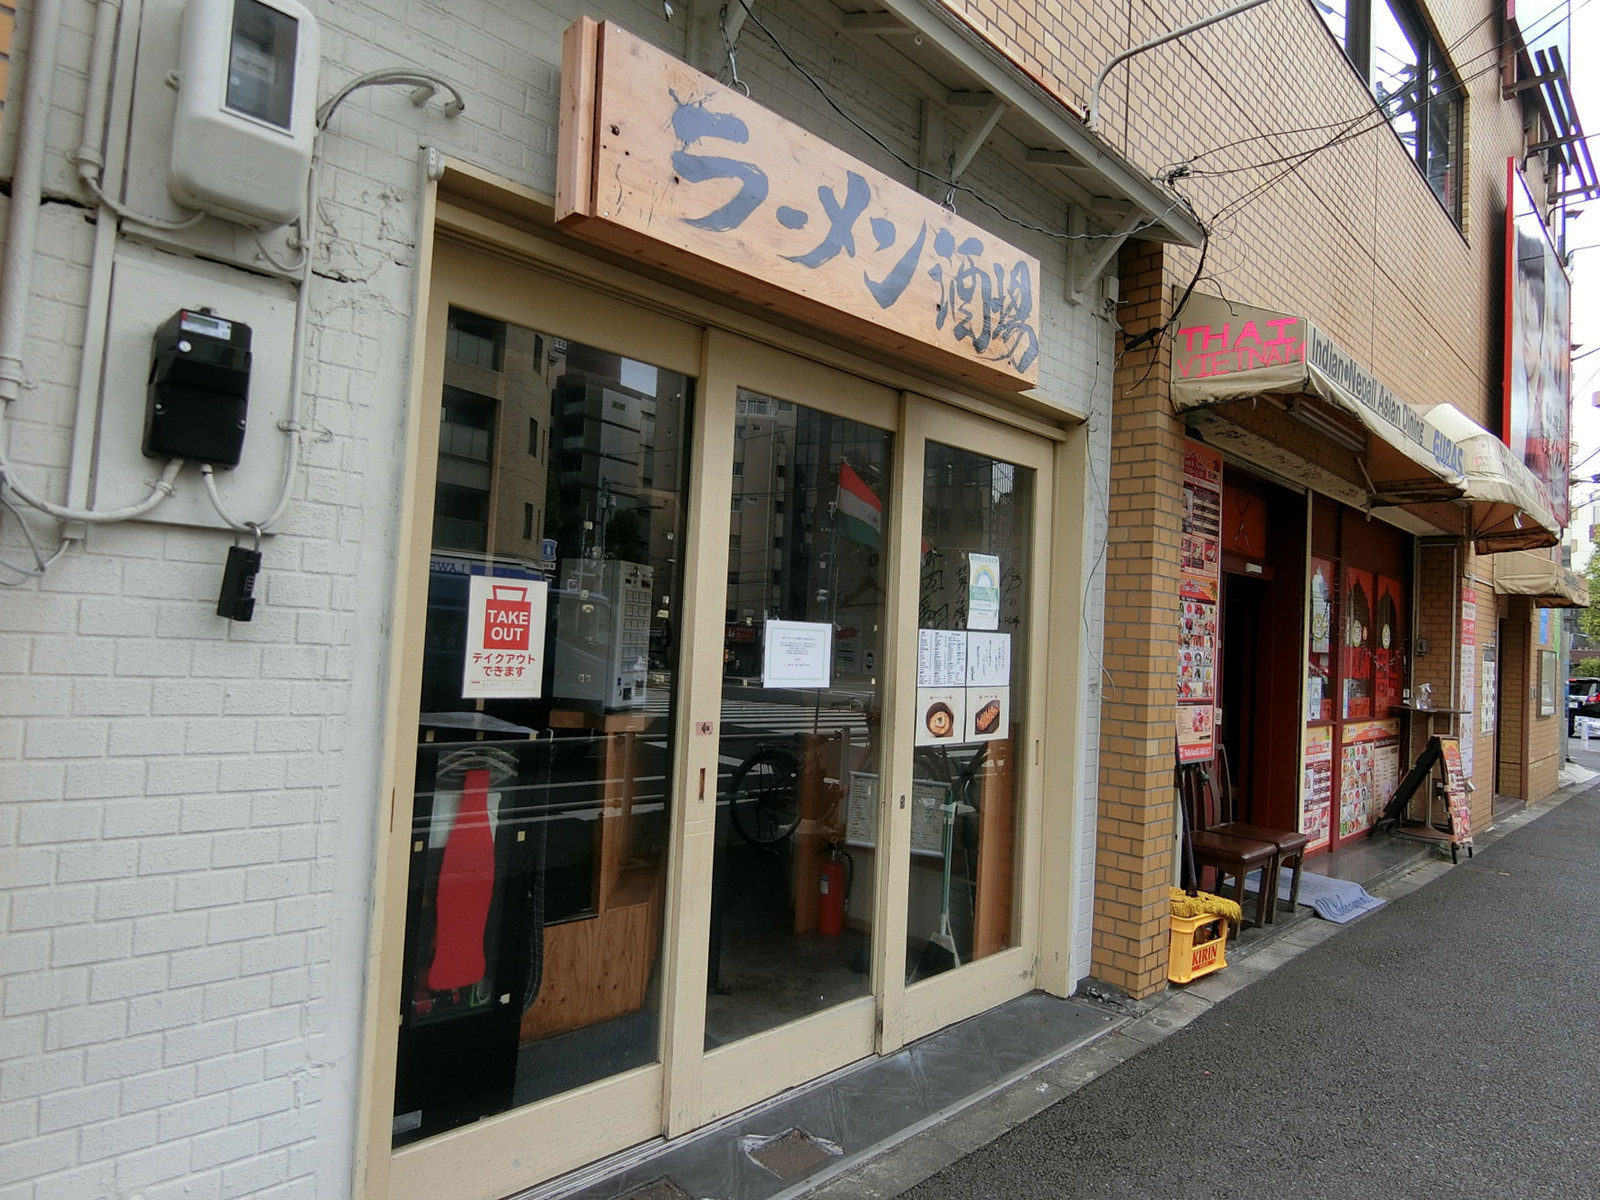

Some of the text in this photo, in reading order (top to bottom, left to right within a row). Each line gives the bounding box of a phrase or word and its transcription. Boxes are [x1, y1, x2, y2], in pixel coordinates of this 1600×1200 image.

[668, 88, 1039, 374] ラーメン酒場
[1177, 317, 1299, 353] THAI
[1177, 341, 1305, 379] VIETNAM
[1378, 385, 1401, 426] Asian
[1402, 404, 1425, 446] Dining
[1433, 429, 1464, 477] GURAS
[487, 609, 529, 625] TAKE
[491, 626, 524, 641] OUT
[472, 652, 536, 665] テイクアウト
[483, 666, 525, 677] できます
[1192, 944, 1218, 966] KIRIN
